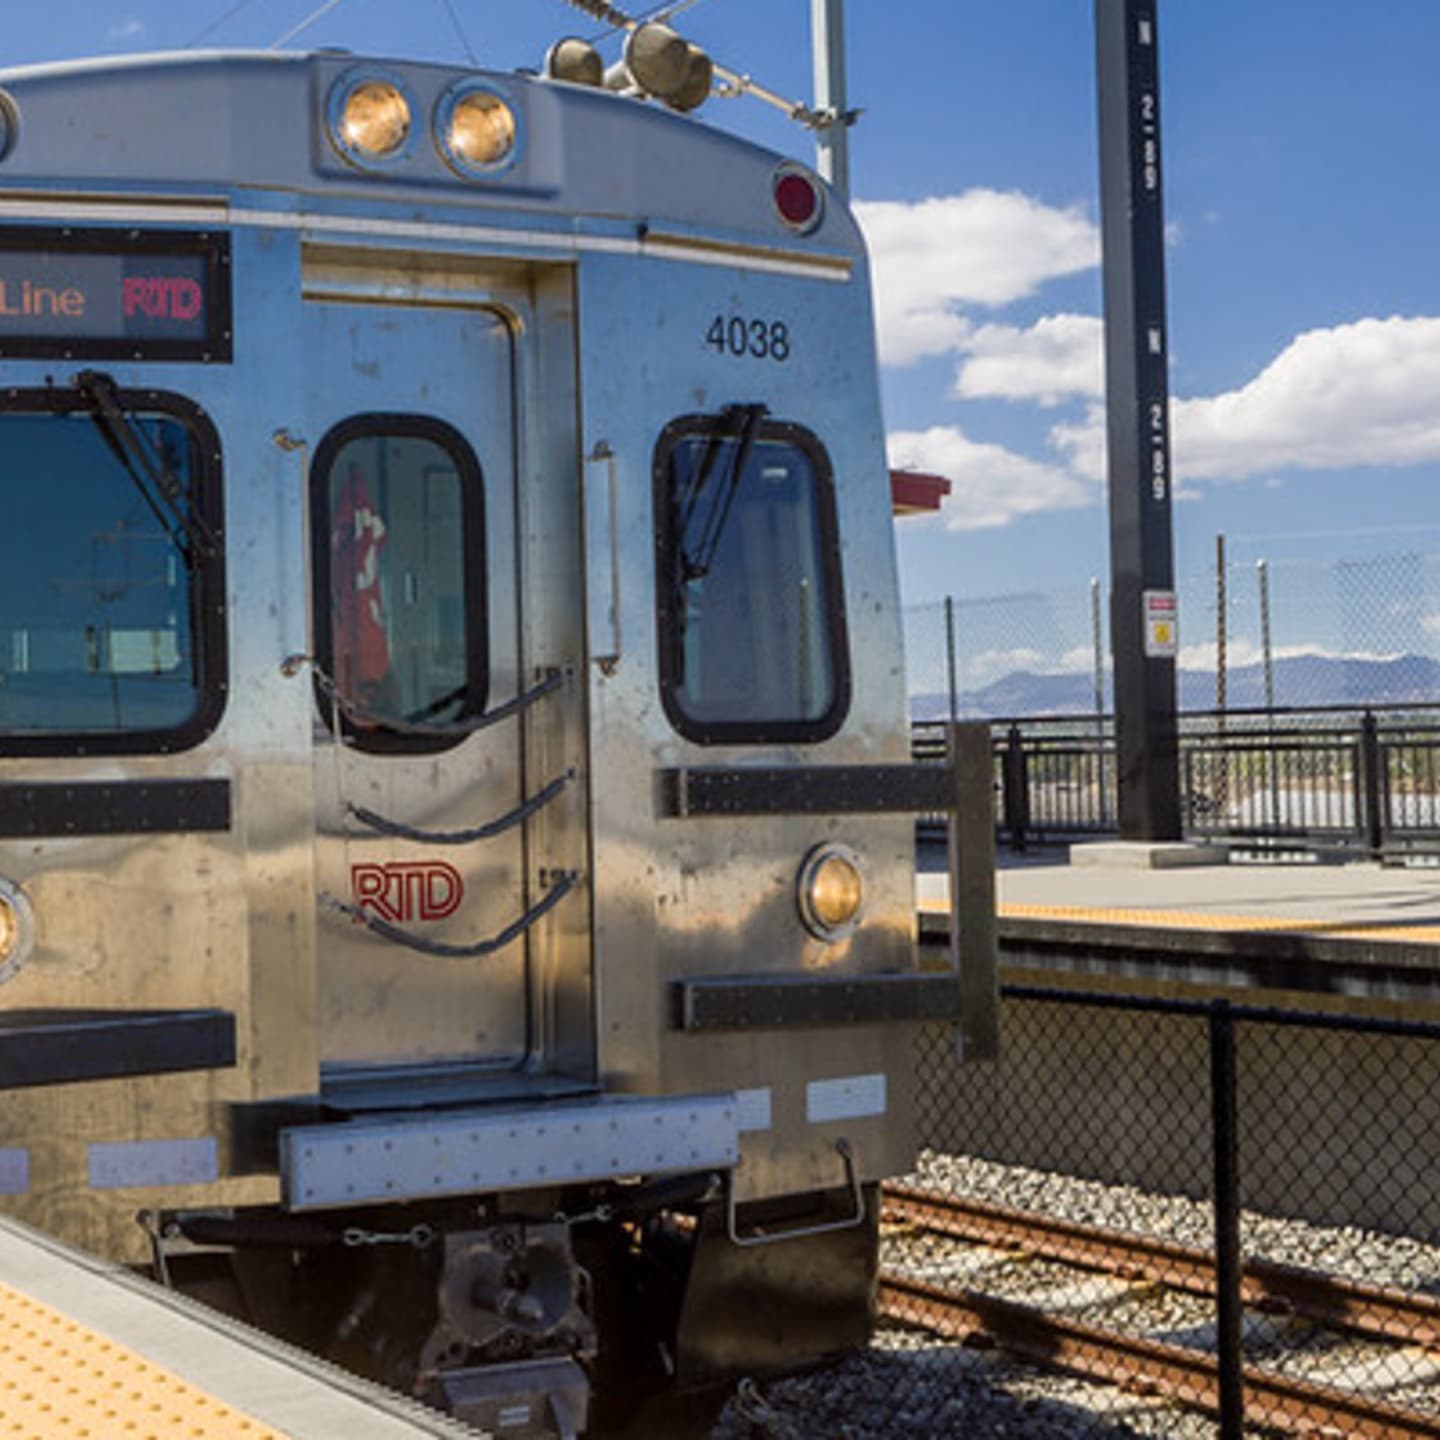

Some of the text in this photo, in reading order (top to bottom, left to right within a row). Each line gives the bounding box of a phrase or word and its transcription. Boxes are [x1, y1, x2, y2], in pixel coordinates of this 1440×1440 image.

[121, 276, 203, 321] RTD
[704, 314, 791, 362] 4038
[350, 861, 464, 923] RTD
